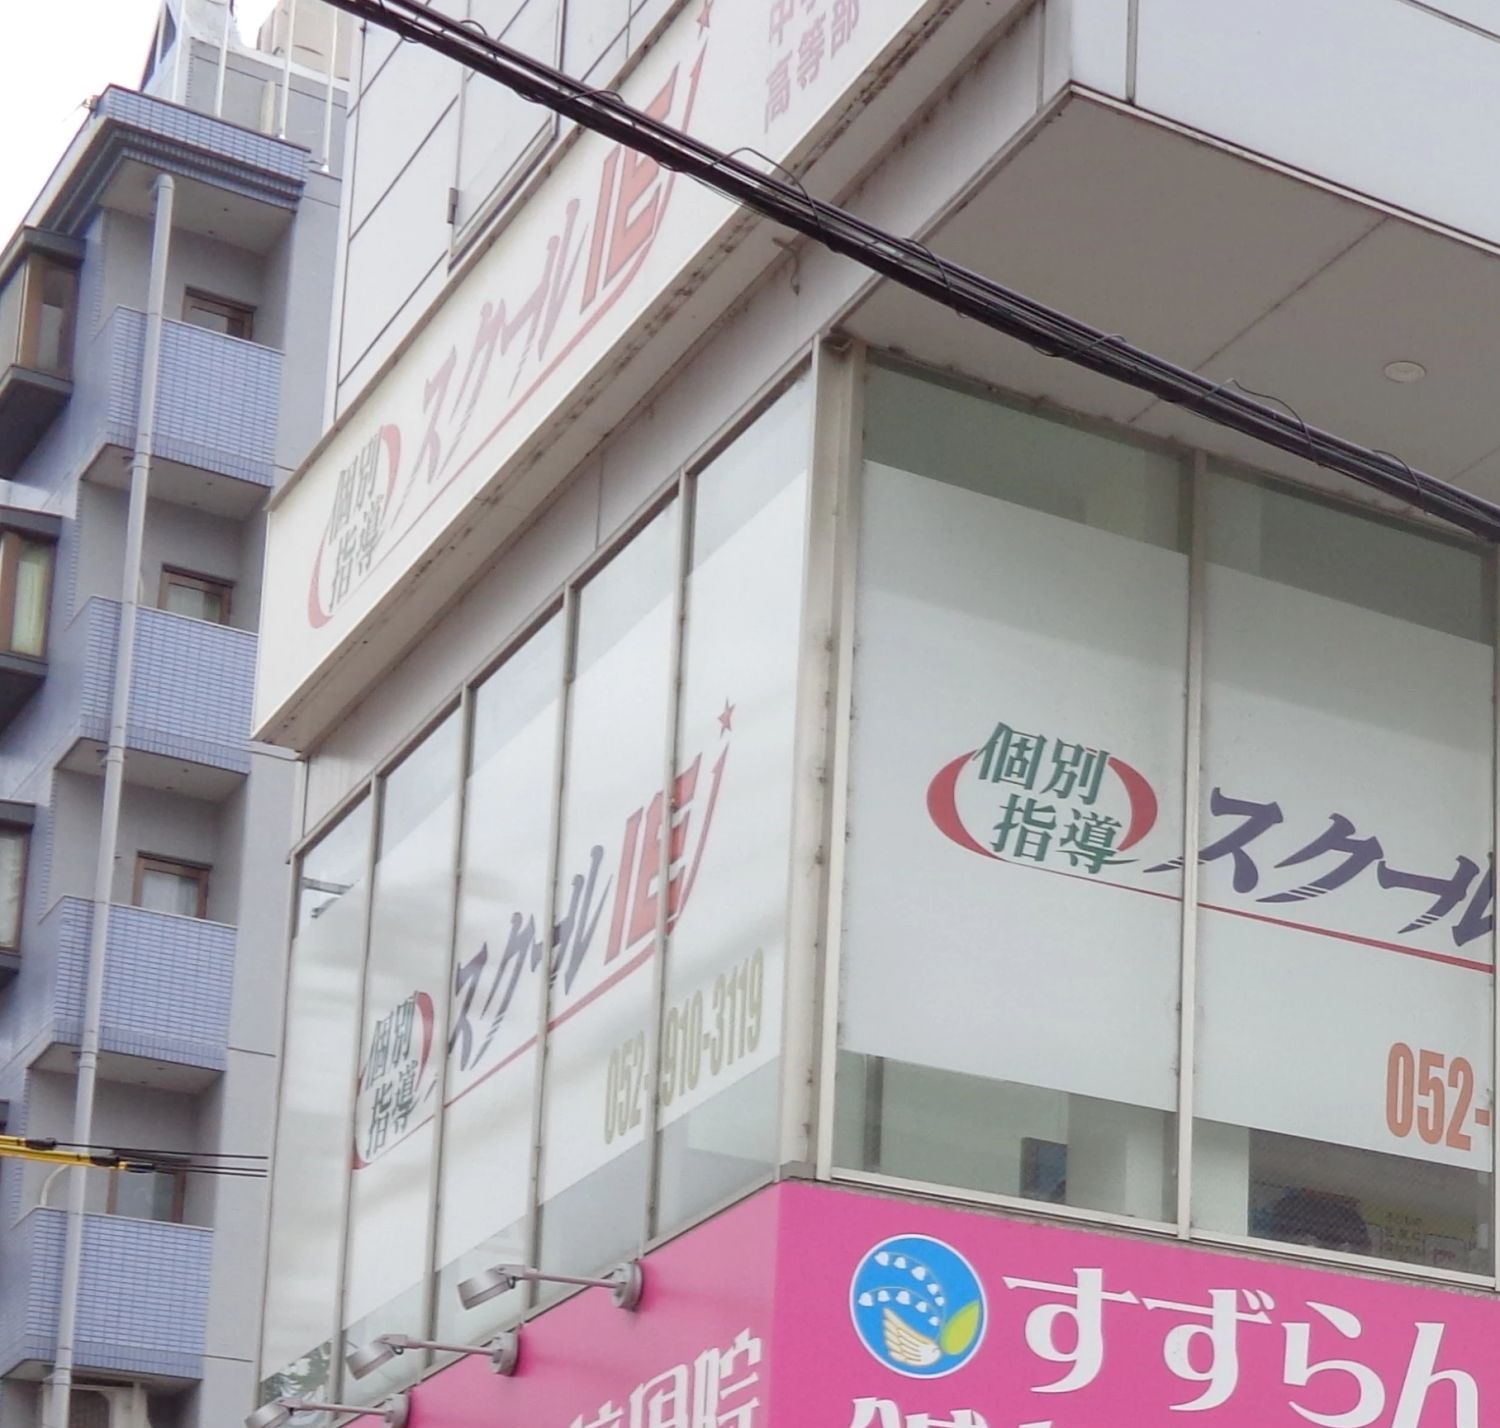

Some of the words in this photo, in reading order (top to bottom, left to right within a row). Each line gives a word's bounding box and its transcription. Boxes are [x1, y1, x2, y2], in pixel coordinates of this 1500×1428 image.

[328, 432, 384, 541] 個別
[329, 493, 386, 613] 指導
[975, 722, 1111, 805] 個別
[991, 792, 1138, 875] 指導
[366, 997, 416, 1091] 個別
[366, 1060, 418, 1158] 指導
